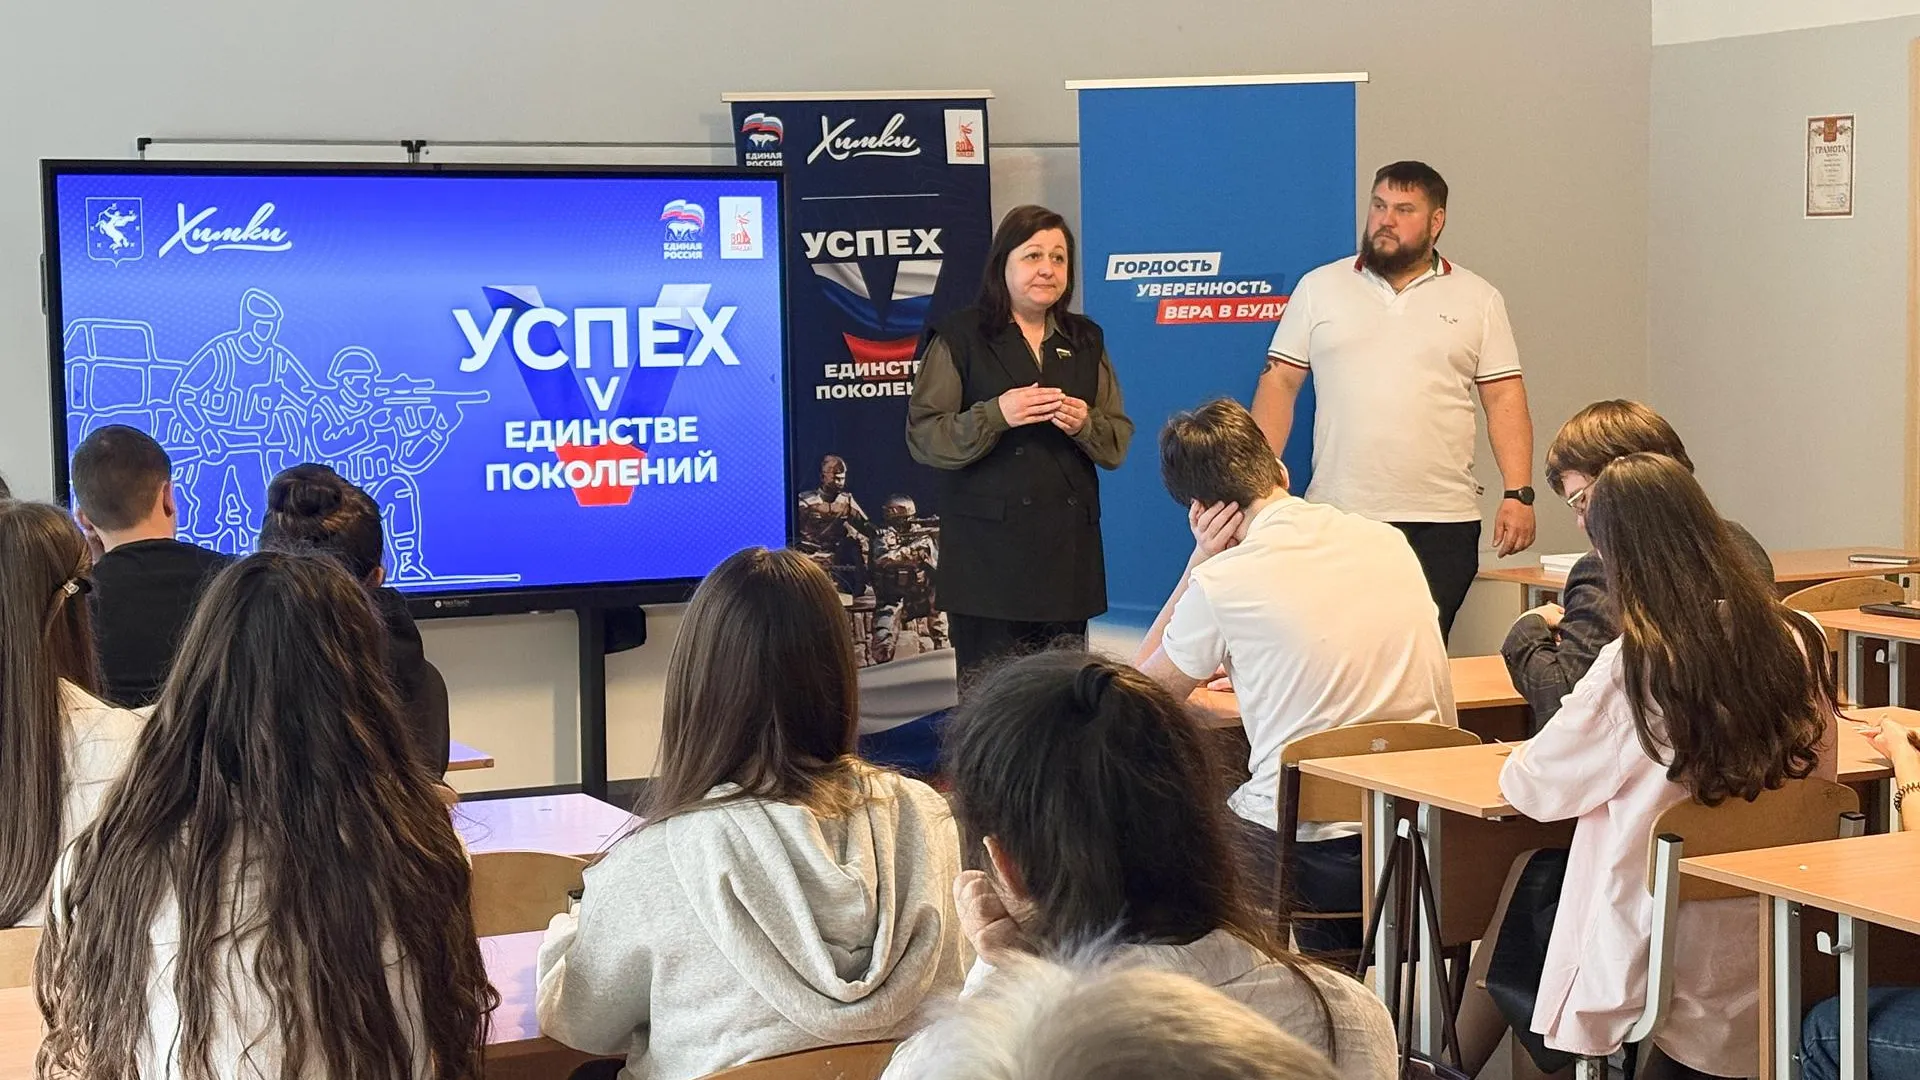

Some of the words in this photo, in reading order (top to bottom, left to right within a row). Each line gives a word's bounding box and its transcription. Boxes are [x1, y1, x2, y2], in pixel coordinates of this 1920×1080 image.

[807, 113, 921, 165] Химки
[1815, 145, 1846, 154] ГРАМОТА
[745, 152, 782, 160] ЕДИНАЯ
[158, 203, 292, 258] Химки
[664, 242, 703, 251] ЕДИНАЯ
[801, 228, 944, 259] УСПЕХ
[664, 251, 703, 260] РОССИЯ
[1114, 259, 1212, 275] ГОРДОСТЬ
[1136, 281, 1272, 297] УВЕРЕННОСТЬ
[1164, 304, 1214, 320] ВЕРА
[1219, 304, 1232, 318] В
[452, 306, 741, 373] УСПЕХ
[585, 376, 620, 411] V
[505, 416, 699, 452] ЕДИНСТВЕ
[486, 450, 718, 491] ПОКОЛЕНИЙ
